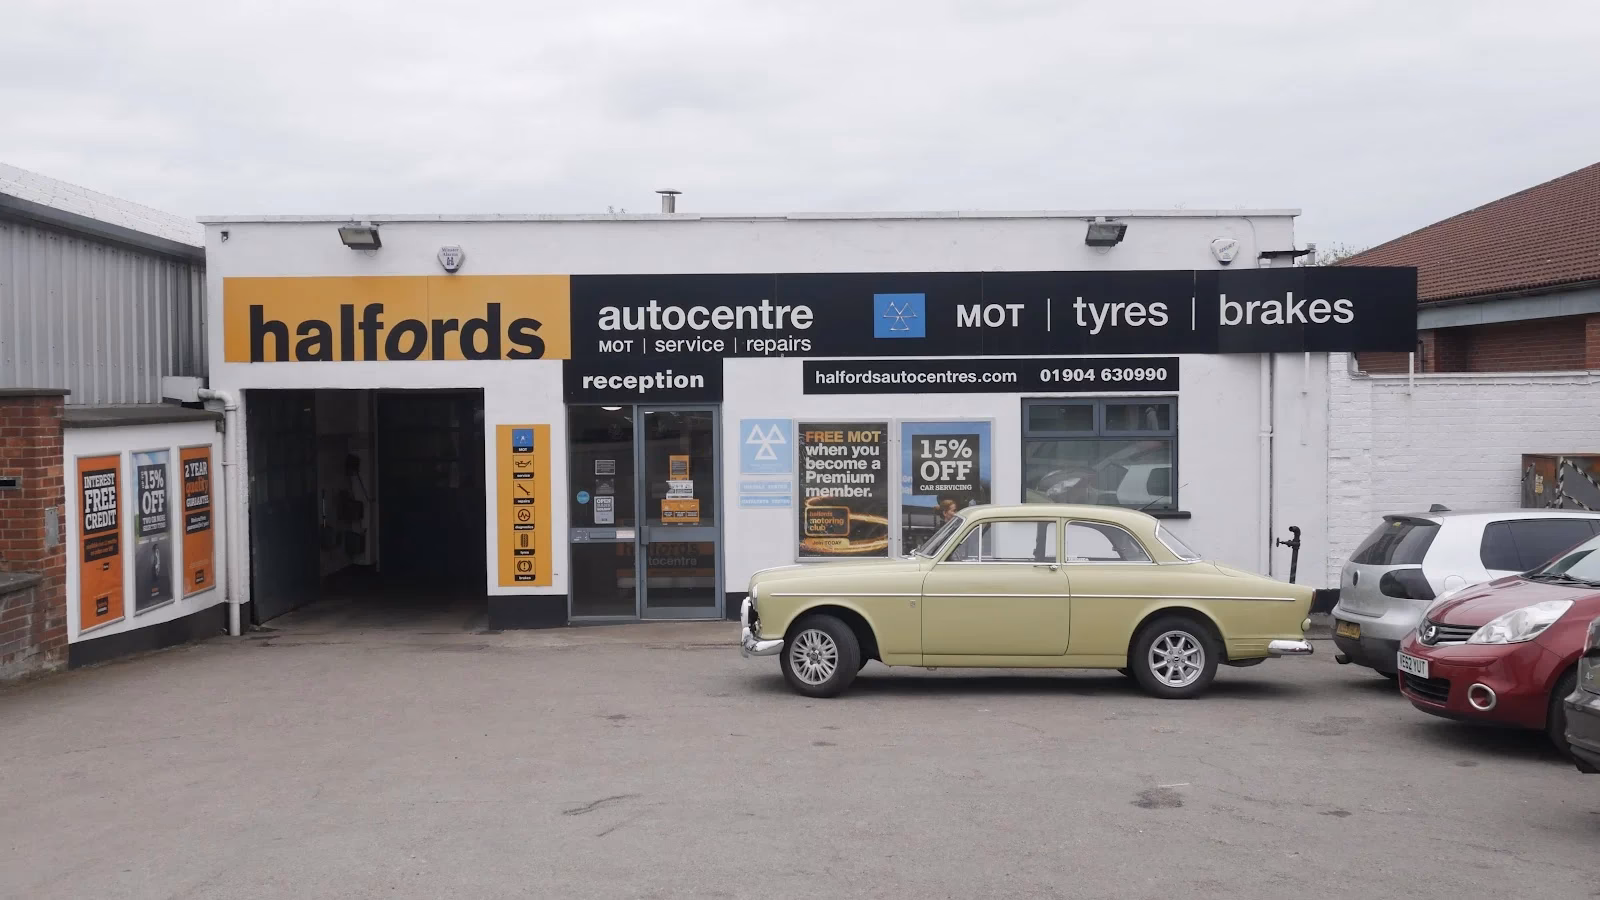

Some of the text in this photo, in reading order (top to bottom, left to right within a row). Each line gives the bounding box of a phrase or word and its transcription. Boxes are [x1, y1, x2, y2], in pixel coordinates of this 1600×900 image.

[598, 299, 814, 331] autocentre
[956, 292, 1355, 335] MOT tyres brakes
[249, 302, 546, 361] halfords
[598, 335, 812, 357] MOT service repairs
[582, 369, 704, 394] reception
[815, 367, 1168, 385] halfordsautocentres.com 01904 630990
[805, 431, 882, 443] FREE MOT
[805, 443, 880, 458] when you
[920, 439, 973, 458] 15%
[185, 462, 208, 478] 2 YEAR
[805, 457, 881, 470] become a
[920, 461, 973, 481] OFF
[84, 474, 115, 488] INTEREST
[144, 469, 164, 489] 15%
[805, 470, 875, 483] Premium
[85, 487, 116, 513] FREE
[805, 484, 873, 497] member.
[143, 490, 165, 515] OFF
[86, 509, 116, 530] CREDIT
[809, 518, 844, 526] motoring
[1413, 659, 1425, 675] YUT
